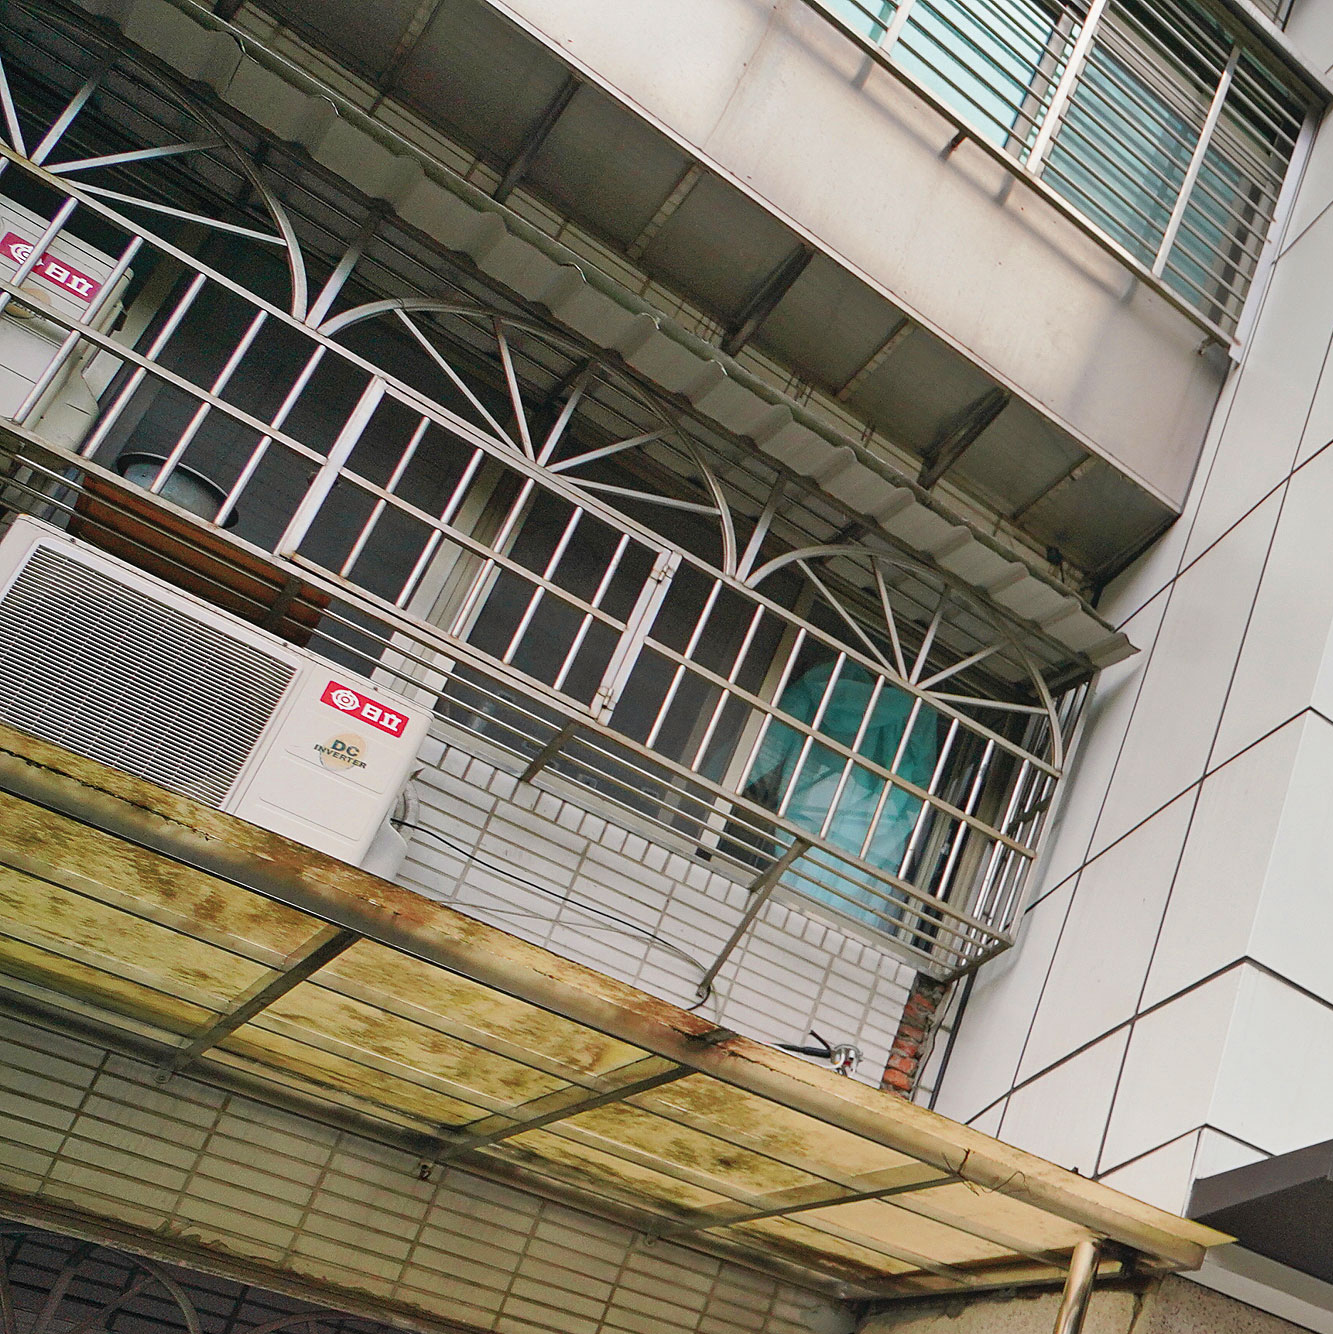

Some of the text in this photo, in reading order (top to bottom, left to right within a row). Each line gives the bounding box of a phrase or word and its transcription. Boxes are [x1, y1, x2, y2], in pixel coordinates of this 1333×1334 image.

[45, 262, 93, 297] 日立
[361, 703, 402, 732] 日立
[314, 744, 367, 769] INVERTER
[332, 740, 360, 757] DC
